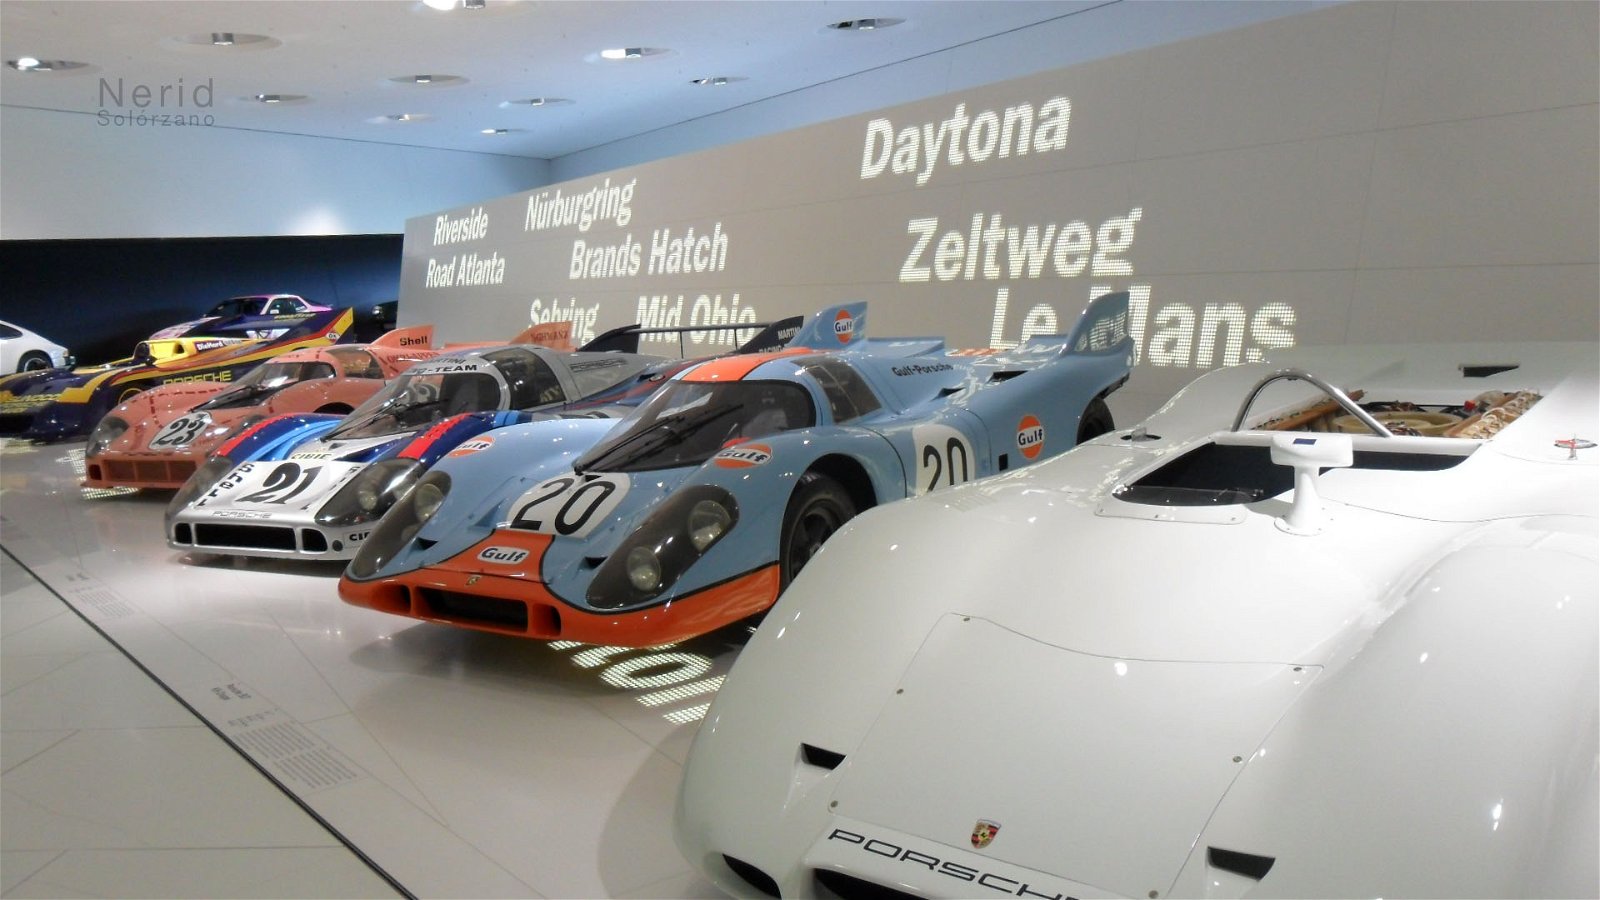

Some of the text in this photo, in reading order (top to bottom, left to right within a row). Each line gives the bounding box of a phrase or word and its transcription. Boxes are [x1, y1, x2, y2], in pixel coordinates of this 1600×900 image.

[860, 96, 1072, 186] Daytona
[433, 206, 489, 247] Riverside
[524, 177, 637, 232] Nürburgring
[569, 221, 729, 280] Brands Hatch
[898, 207, 1143, 283] Zeltweg
[425, 252, 506, 288] Road Atlanta
[400, 335, 428, 347] Shell
[635, 293, 757, 346] Mid Ohio
[834, 320, 853, 332] Gulf
[988, 288, 1058, 352] Le
[154, 413, 208, 447] 23
[1017, 428, 1043, 446] Gulf
[719, 449, 768, 462] Gulf
[922, 436, 969, 493] 20
[235, 462, 322, 505] 21
[509, 477, 617, 536] 20
[481, 547, 526, 562] Gulf
[827, 828, 1079, 900] PORSCH
